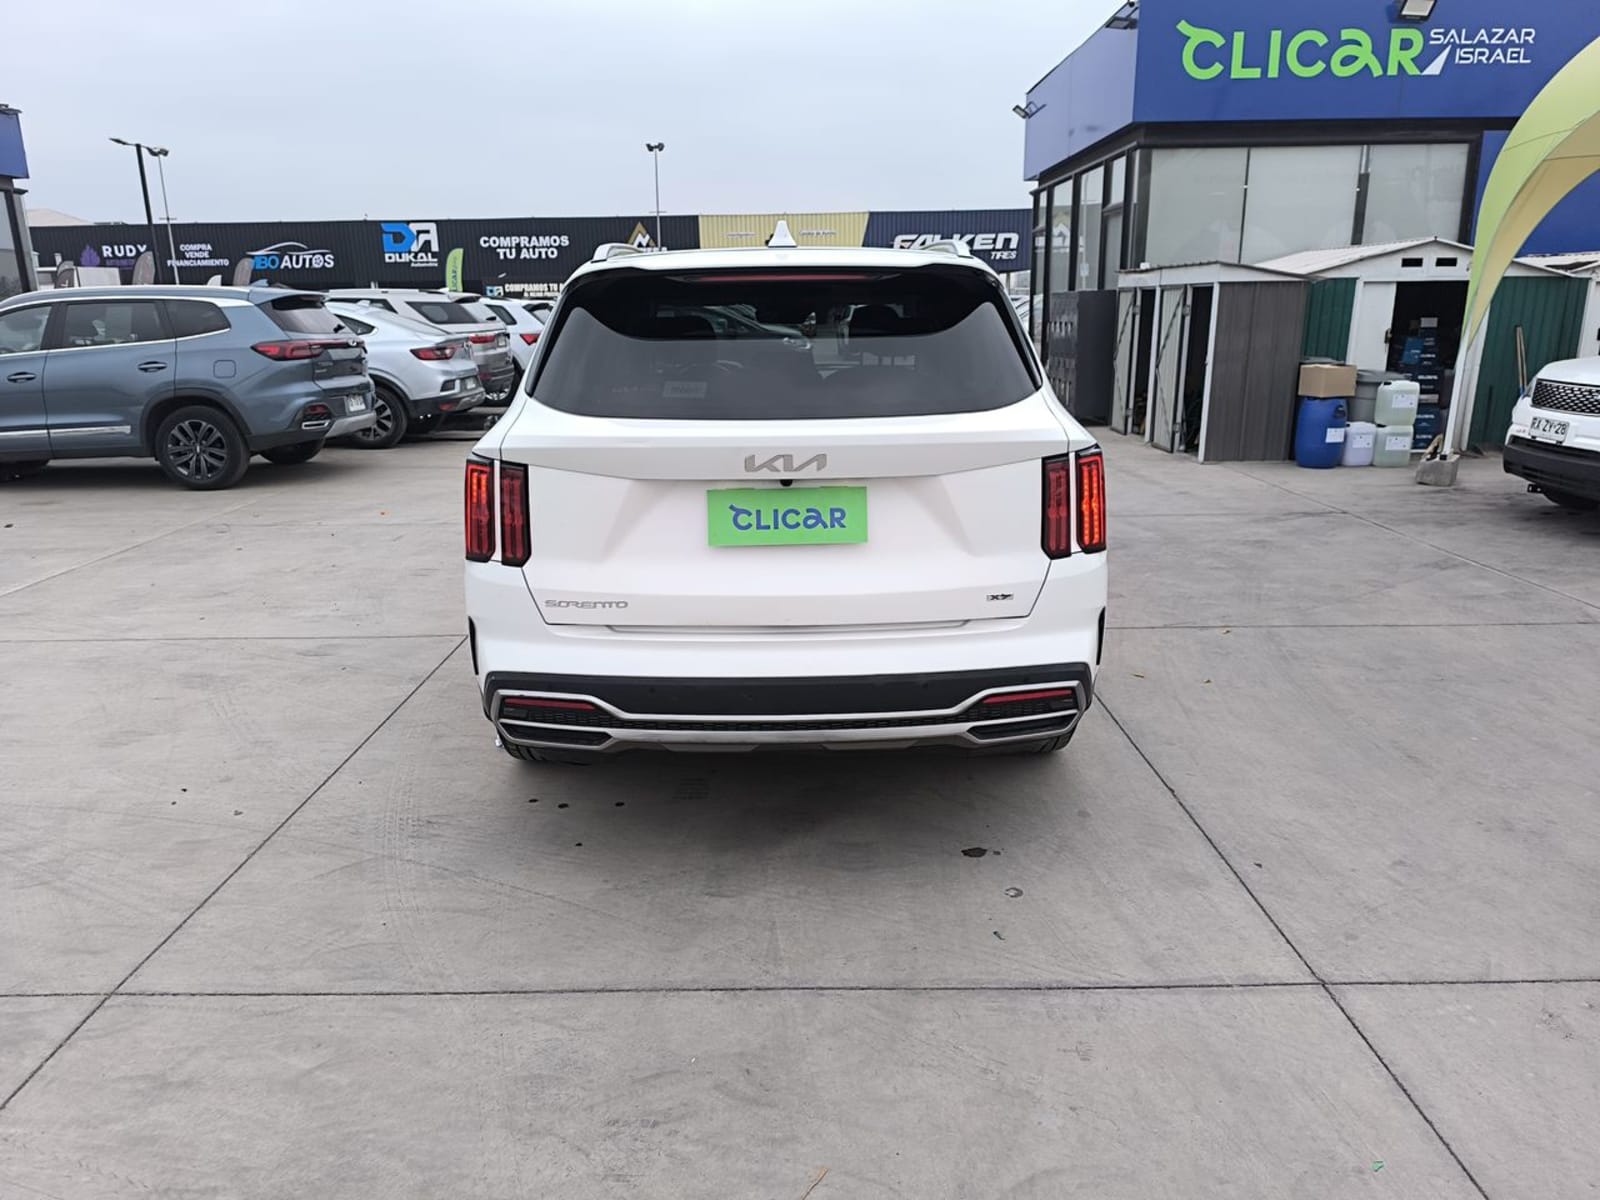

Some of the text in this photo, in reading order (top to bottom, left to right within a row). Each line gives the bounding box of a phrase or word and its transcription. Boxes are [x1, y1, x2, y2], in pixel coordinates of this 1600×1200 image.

[1429, 27, 1536, 46] SALAZAR
[1454, 47, 1532, 65] ISRAEL
[179, 243, 213, 252] COMPRA
[479, 234, 570, 249] COMPRAMOS
[184, 251, 210, 259] VENDE
[384, 252, 438, 263] DUKAL
[496, 247, 559, 260] TU AUTO
[990, 250, 1017, 261] TIRES
[280, 254, 335, 270] AUTOS
[544, 599, 629, 609] SORENTO
